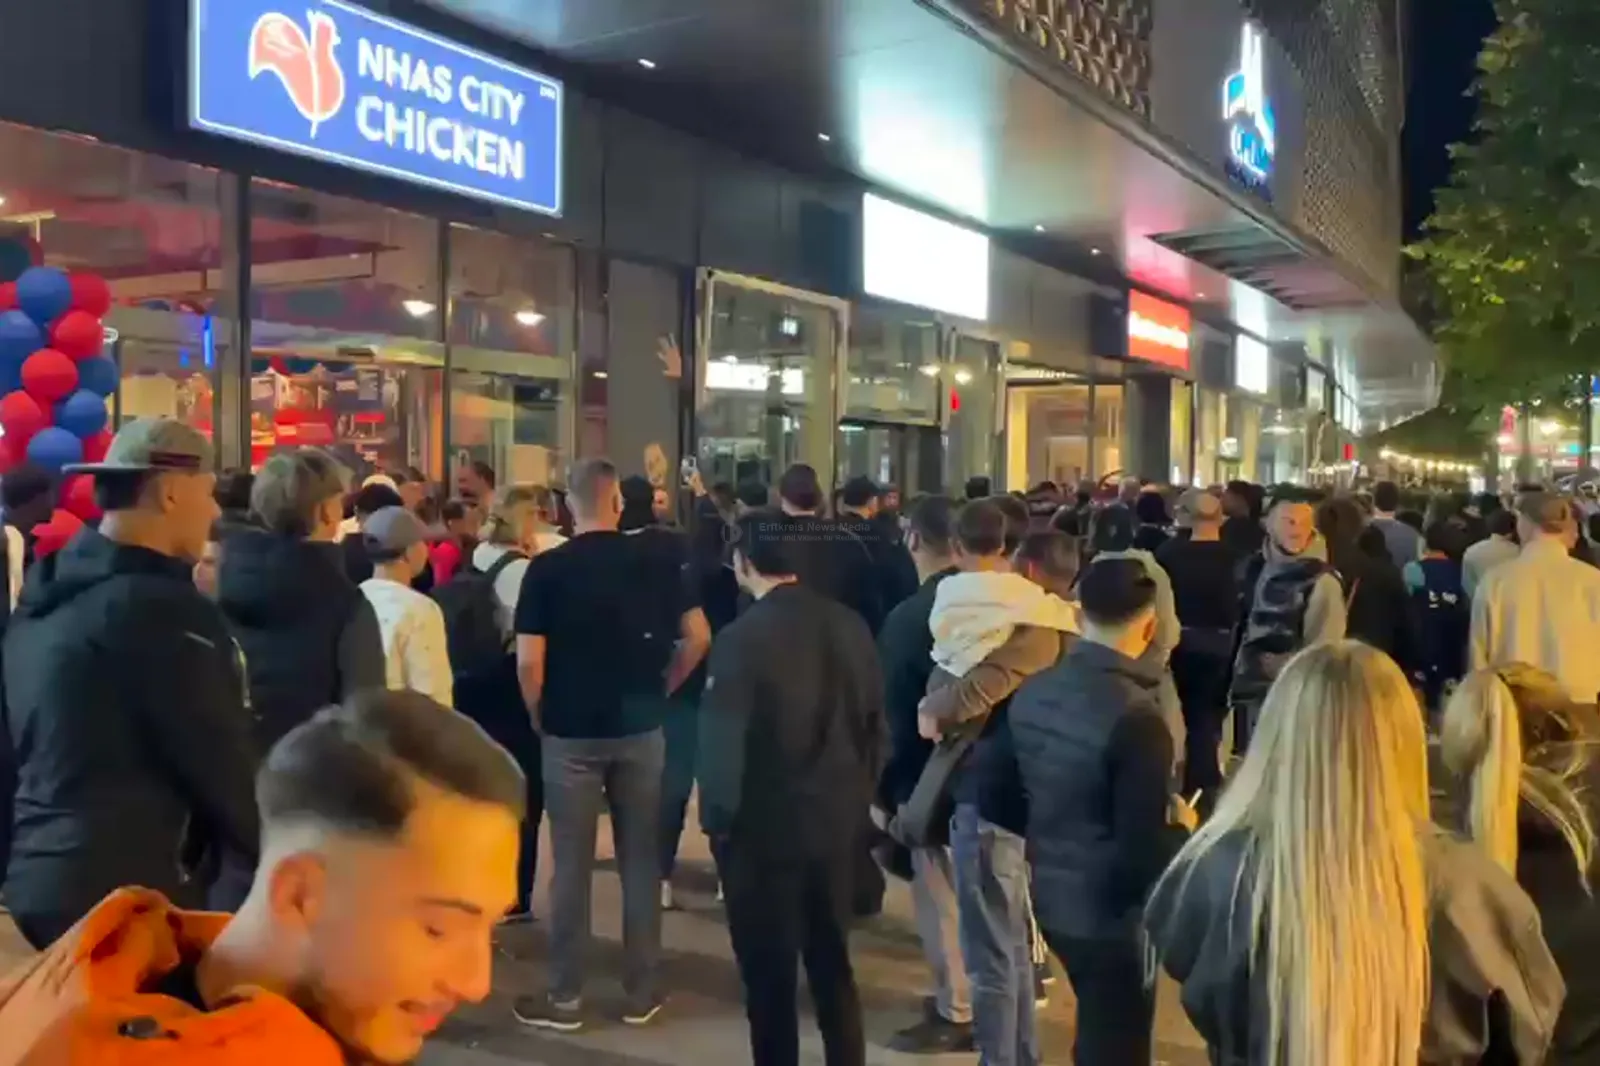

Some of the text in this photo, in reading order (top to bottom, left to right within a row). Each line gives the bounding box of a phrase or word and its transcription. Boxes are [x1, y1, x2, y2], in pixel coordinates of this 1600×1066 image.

[358, 37, 526, 126] NHAS CITY
[355, 95, 526, 180] CHICKEN
